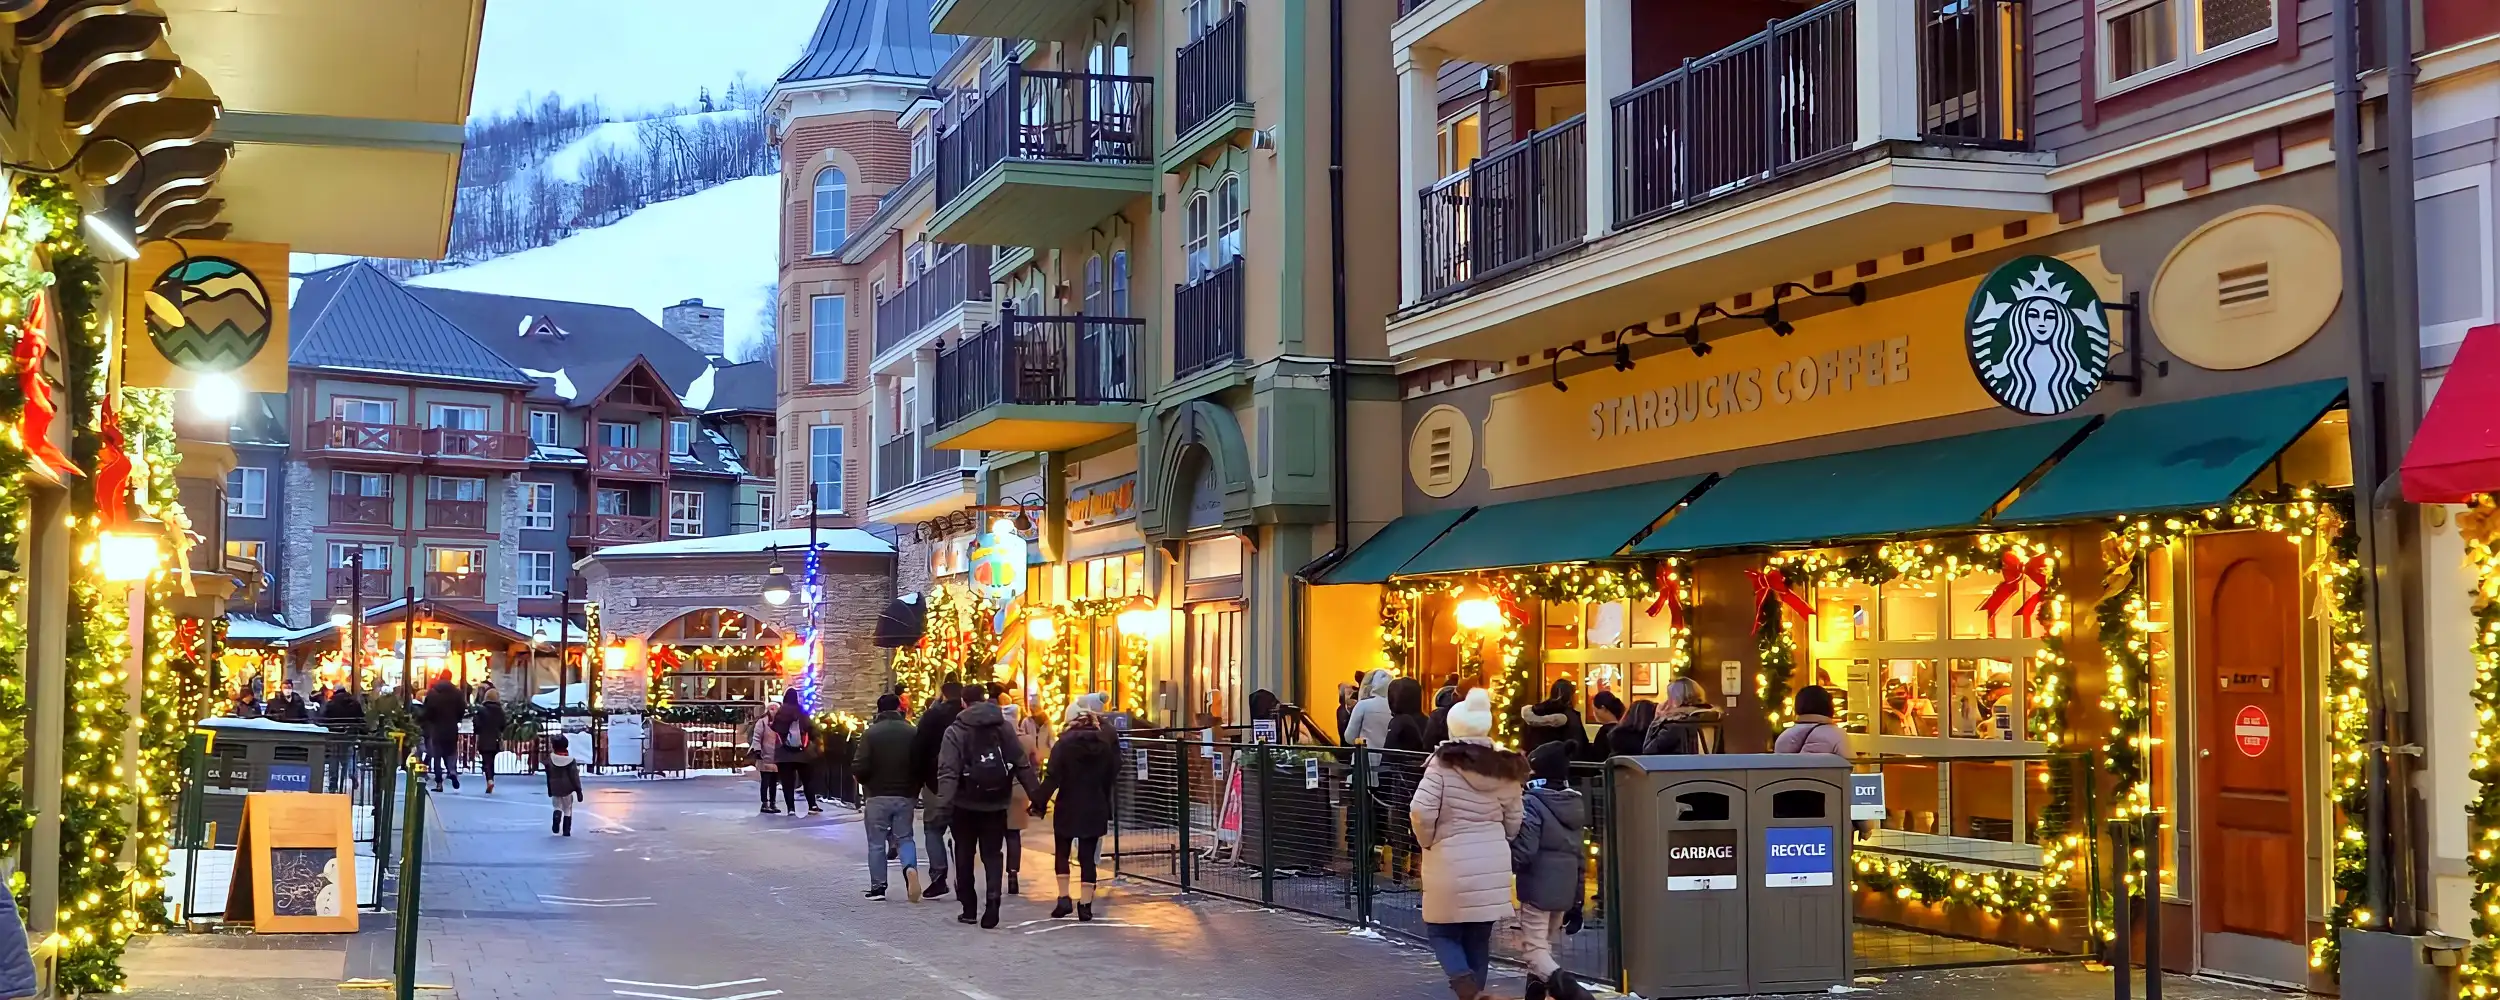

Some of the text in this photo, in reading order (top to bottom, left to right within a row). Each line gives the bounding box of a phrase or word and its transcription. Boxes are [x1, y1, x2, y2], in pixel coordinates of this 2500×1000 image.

[1589, 334, 1910, 440] STARBUCKS COFFEE
[207, 769, 248, 779] GAAGE
[271, 773, 306, 782] RECYCLE
[1855, 786, 1877, 796] EXIT
[1670, 846, 1733, 859] GARBAGE
[1771, 844, 1826, 857] RECYCLE
